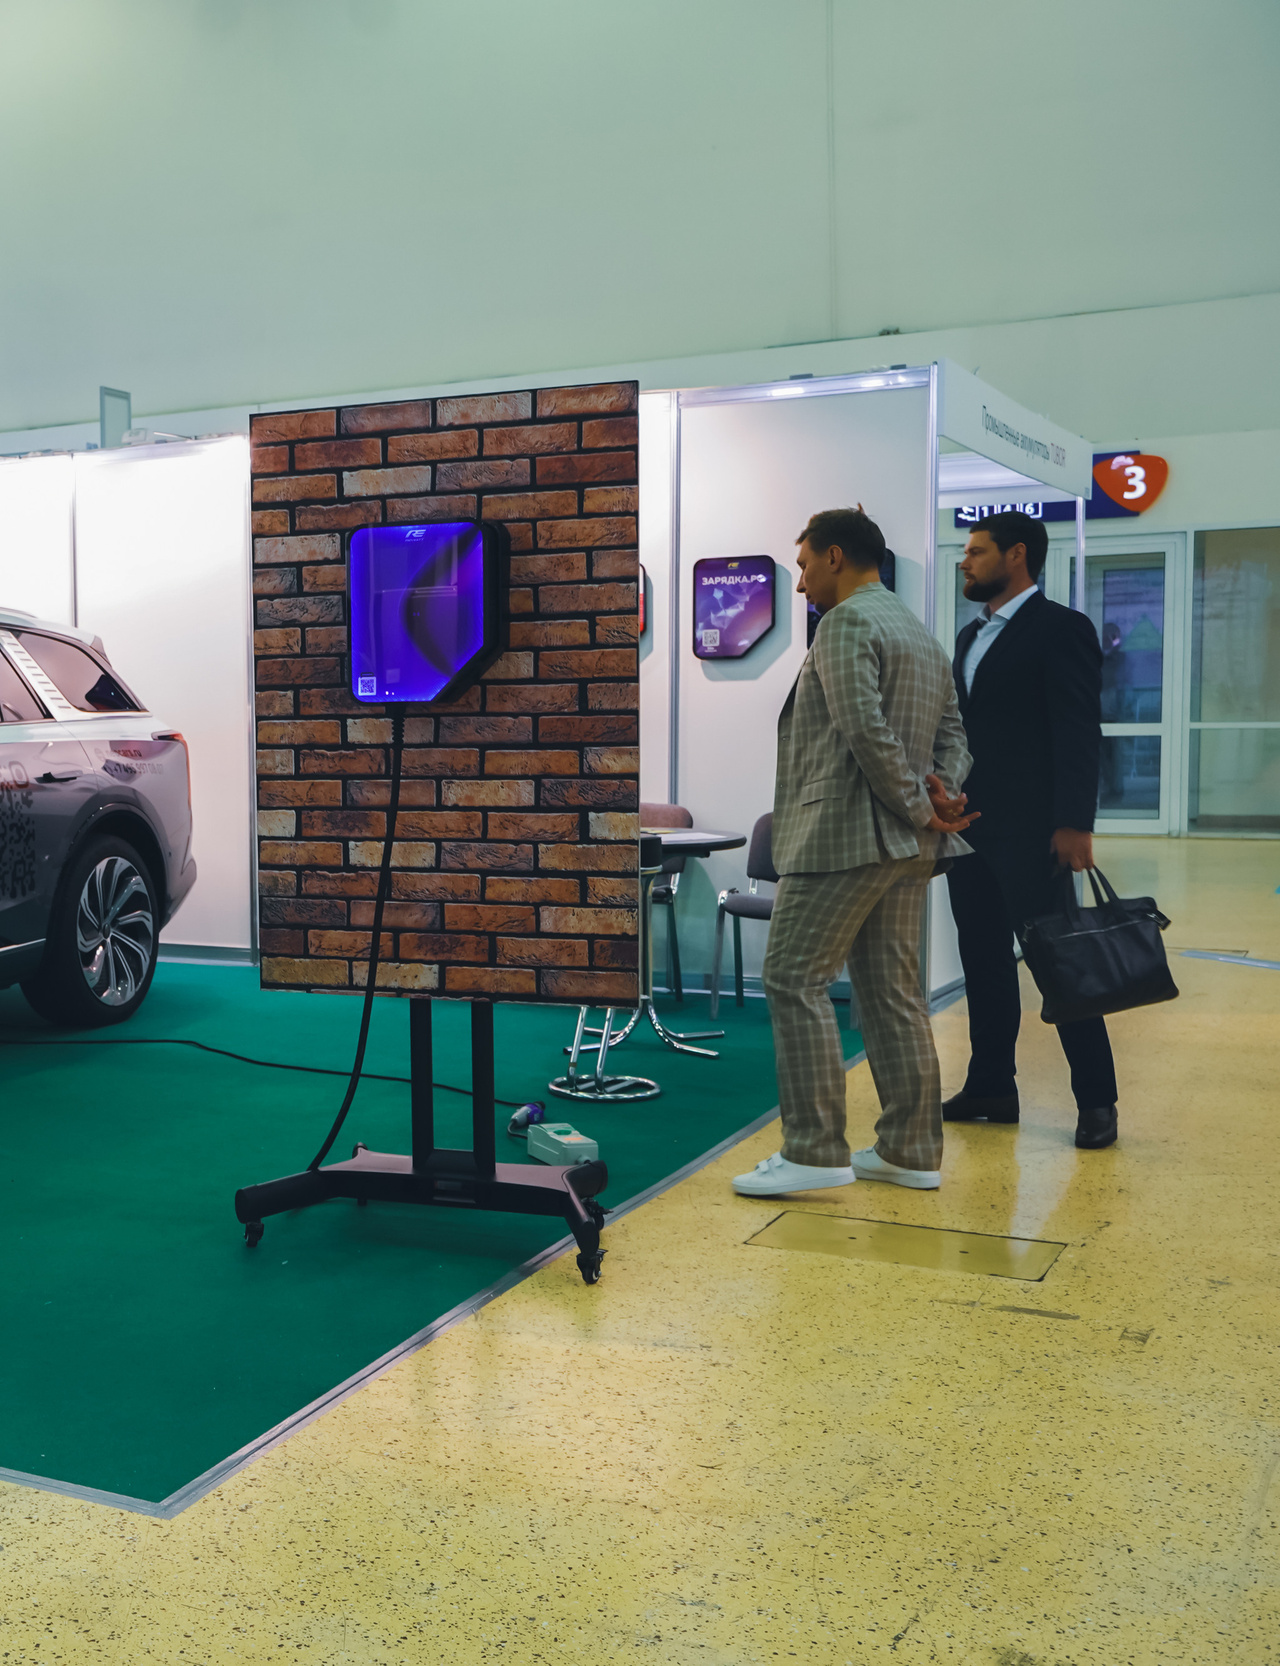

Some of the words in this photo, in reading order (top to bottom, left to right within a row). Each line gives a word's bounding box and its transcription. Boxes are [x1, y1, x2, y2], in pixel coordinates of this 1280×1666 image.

[1123, 466, 1147, 499] 3
[981, 505, 989, 517] 1
[1025, 503, 1035, 515] 6
